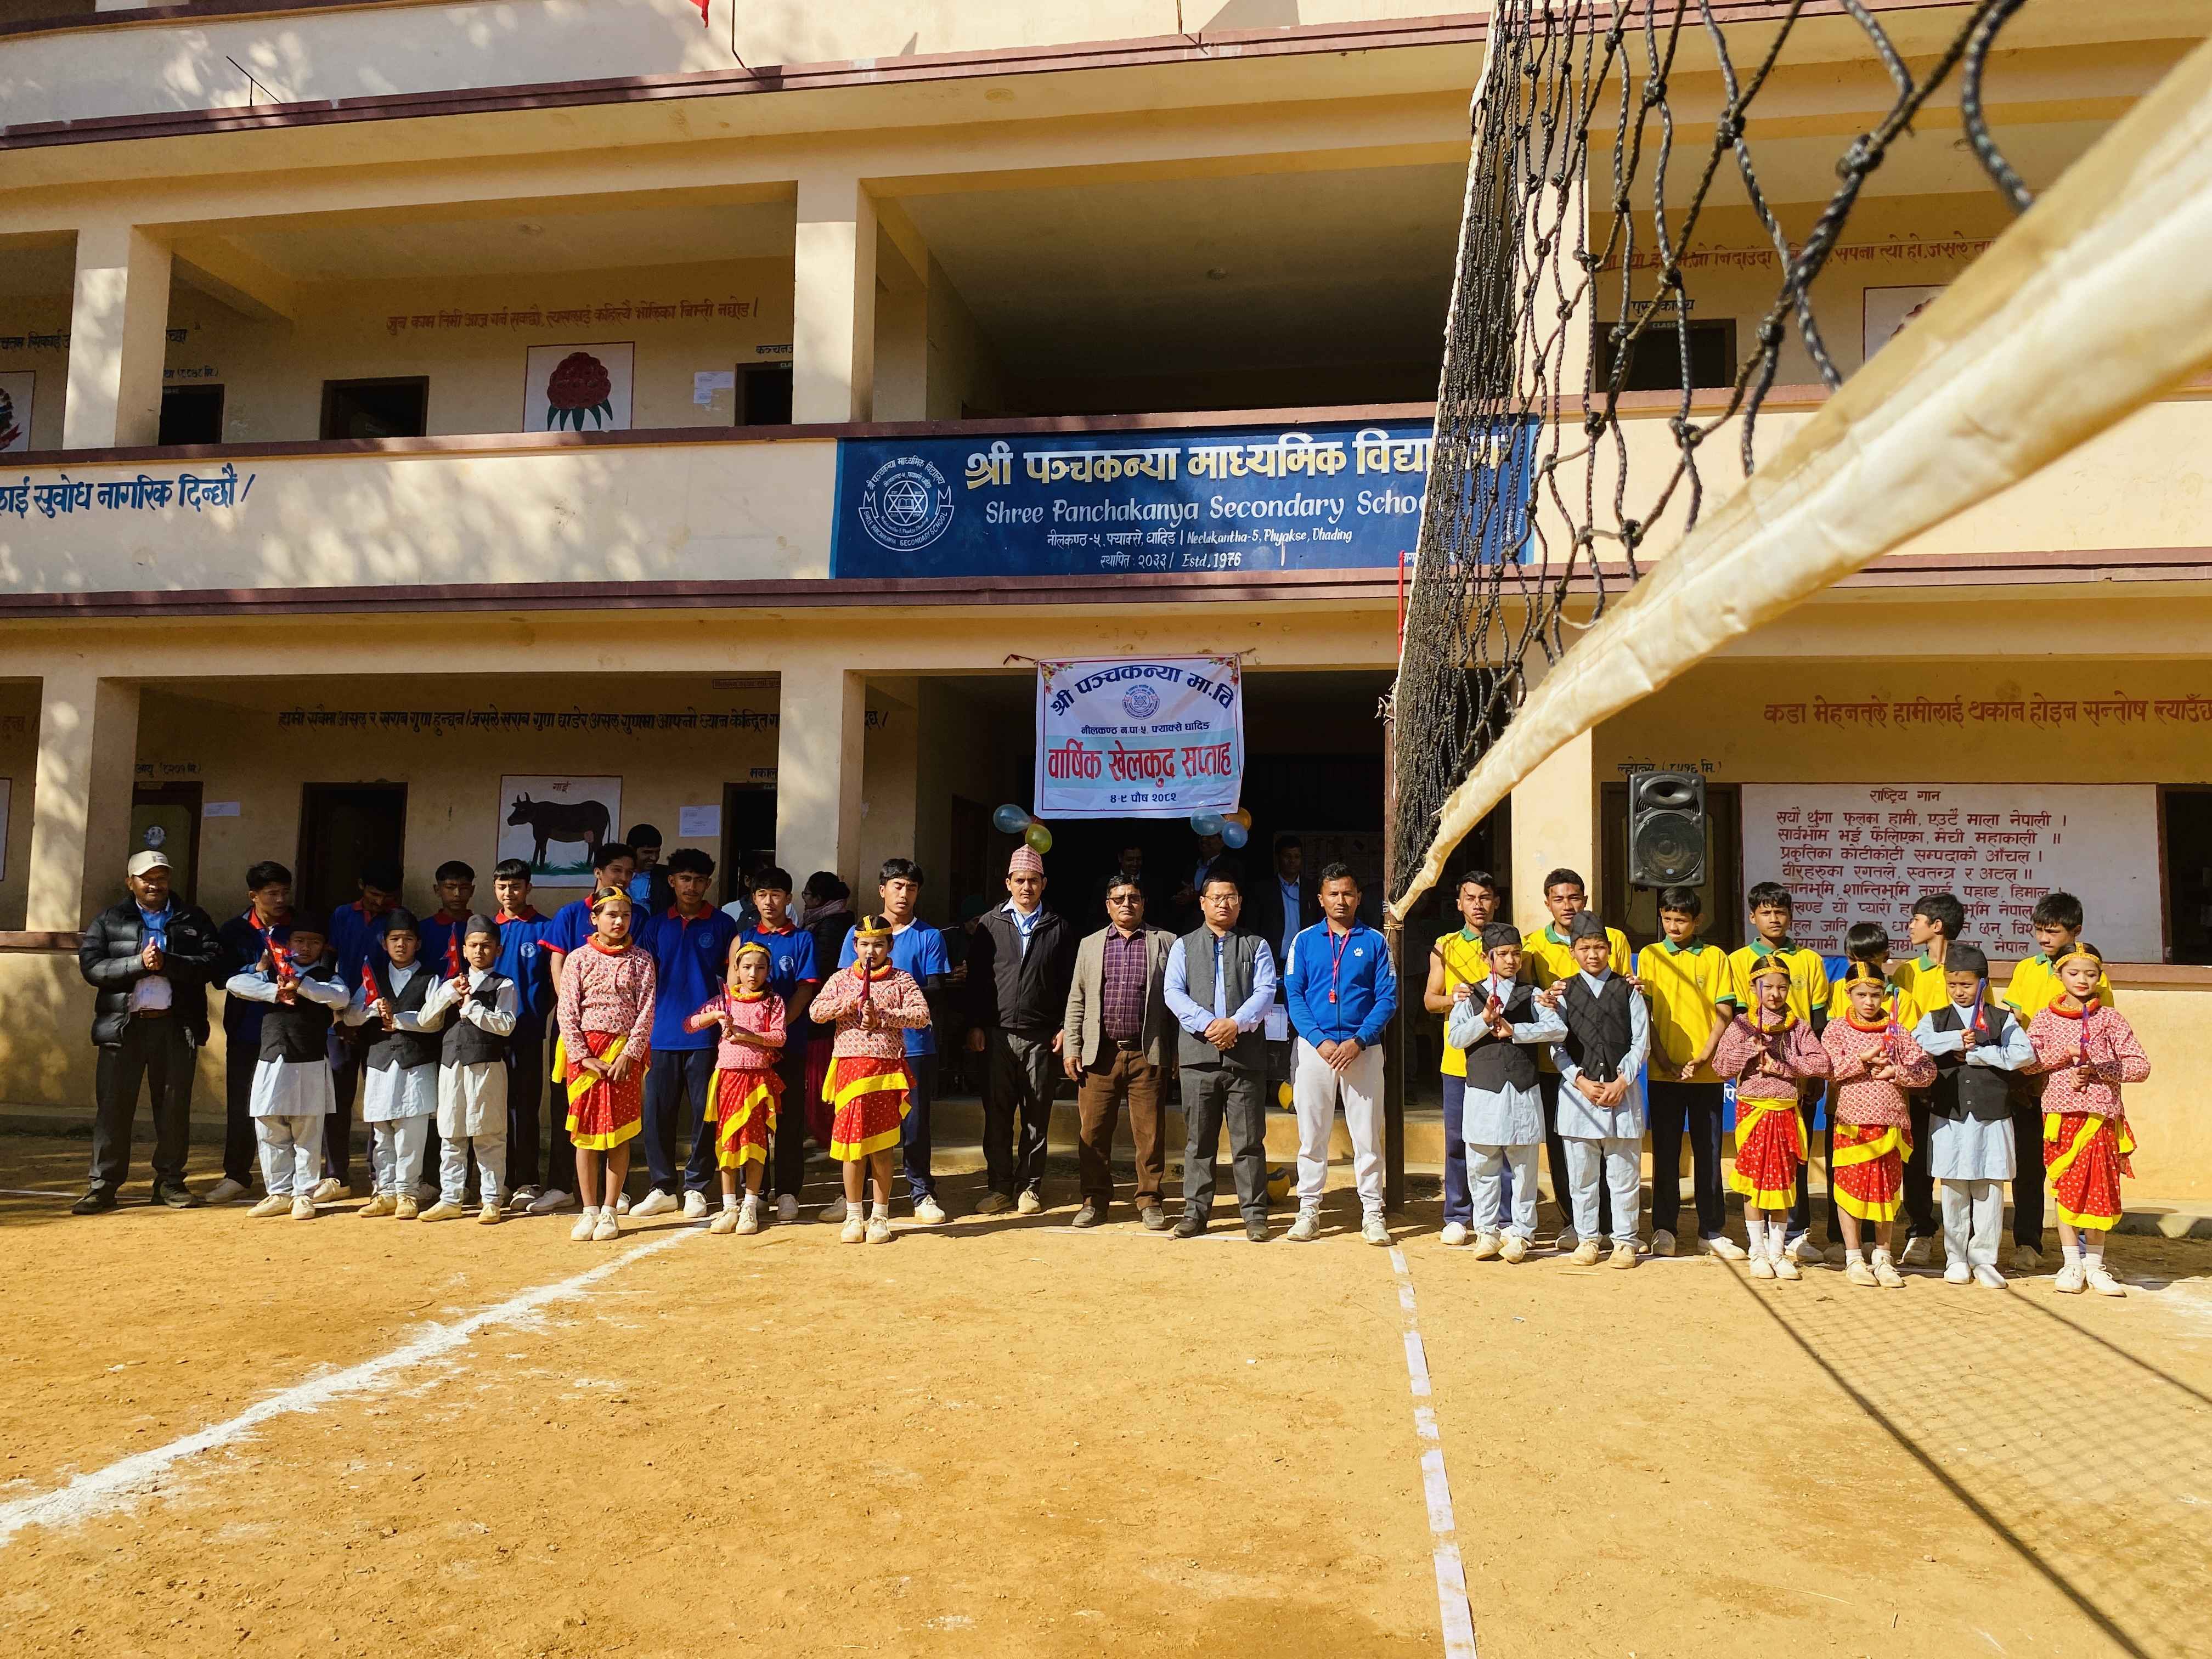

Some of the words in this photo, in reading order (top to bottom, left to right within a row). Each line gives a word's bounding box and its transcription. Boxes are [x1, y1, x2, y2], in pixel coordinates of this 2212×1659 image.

[965, 441, 1013, 489] श्री
[1024, 447, 1181, 483] पञ्चकन्या
[1188, 432, 1347, 479] माध्यमिक
[98, 475, 174, 511] नागरिक
[986, 501, 1043, 523] Shree
[1053, 498, 1198, 527] Panchakanya
[1210, 493, 1344, 524] Secondary
[1187, 530, 1262, 545] Neelakantha-5,
[1264, 529, 1310, 546] Phyakse,
[1312, 528, 1352, 543] Dhading
[1181, 554, 1211, 568] Estd.
[1214, 552, 1242, 568] 1976
[1050, 689, 1075, 716] श्री
[1074, 664, 1183, 694] पञ्चकन्या
[1764, 703, 1807, 725] कडा
[1813, 695, 1888, 729] मेहनतले
[1892, 693, 1965, 730] हामीलाई
[1968, 701, 2025, 723] थकान
[2028, 692, 2077, 730] होइन
[2081, 690, 2149, 727] सन्तोष
[1081, 725, 1118, 735] नीलकण्ठ
[1048, 738, 1103, 780] वार्षिक
[1108, 740, 1176, 788] खेलकुद
[1181, 742, 1232, 779] सप्ताह
[1131, 791, 1149, 803] पौष
[1152, 793, 1177, 803] २०८२
[1870, 788, 1908, 804] राष्ट्रिय
[1917, 791, 1942, 802] गान
[1843, 812, 1880, 827] फूलका
[1927, 808, 1959, 827] एउटै
[1967, 814, 2000, 828] माला
[2010, 810, 2052, 829] नेपाली
[1779, 826, 1830, 843] सार्वभौम
[1934, 828, 1965, 843] मेची
[1974, 830, 2038, 847] महाकाली
[1780, 844, 1833, 862] प्रकृतिका
[1841, 844, 1905, 861] कोटीकोटी
[1914, 846, 1978, 863] सम्पदाको
[1908, 867, 1955, 882] स्वतन्त्र
[1965, 867, 1974, 882] र
[1979, 868, 2018, 884] अटल
[1843, 881, 1910, 904] शान्तिभूमि
[2010, 884, 2050, 902] हिमाल
[1791, 901, 1823, 919] खण्ड
[1832, 898, 1848, 917] यो
[1999, 900, 2034, 922] नेपाल
[1820, 917, 1848, 935] जाति
[1994, 935, 2030, 957] नेपाल
